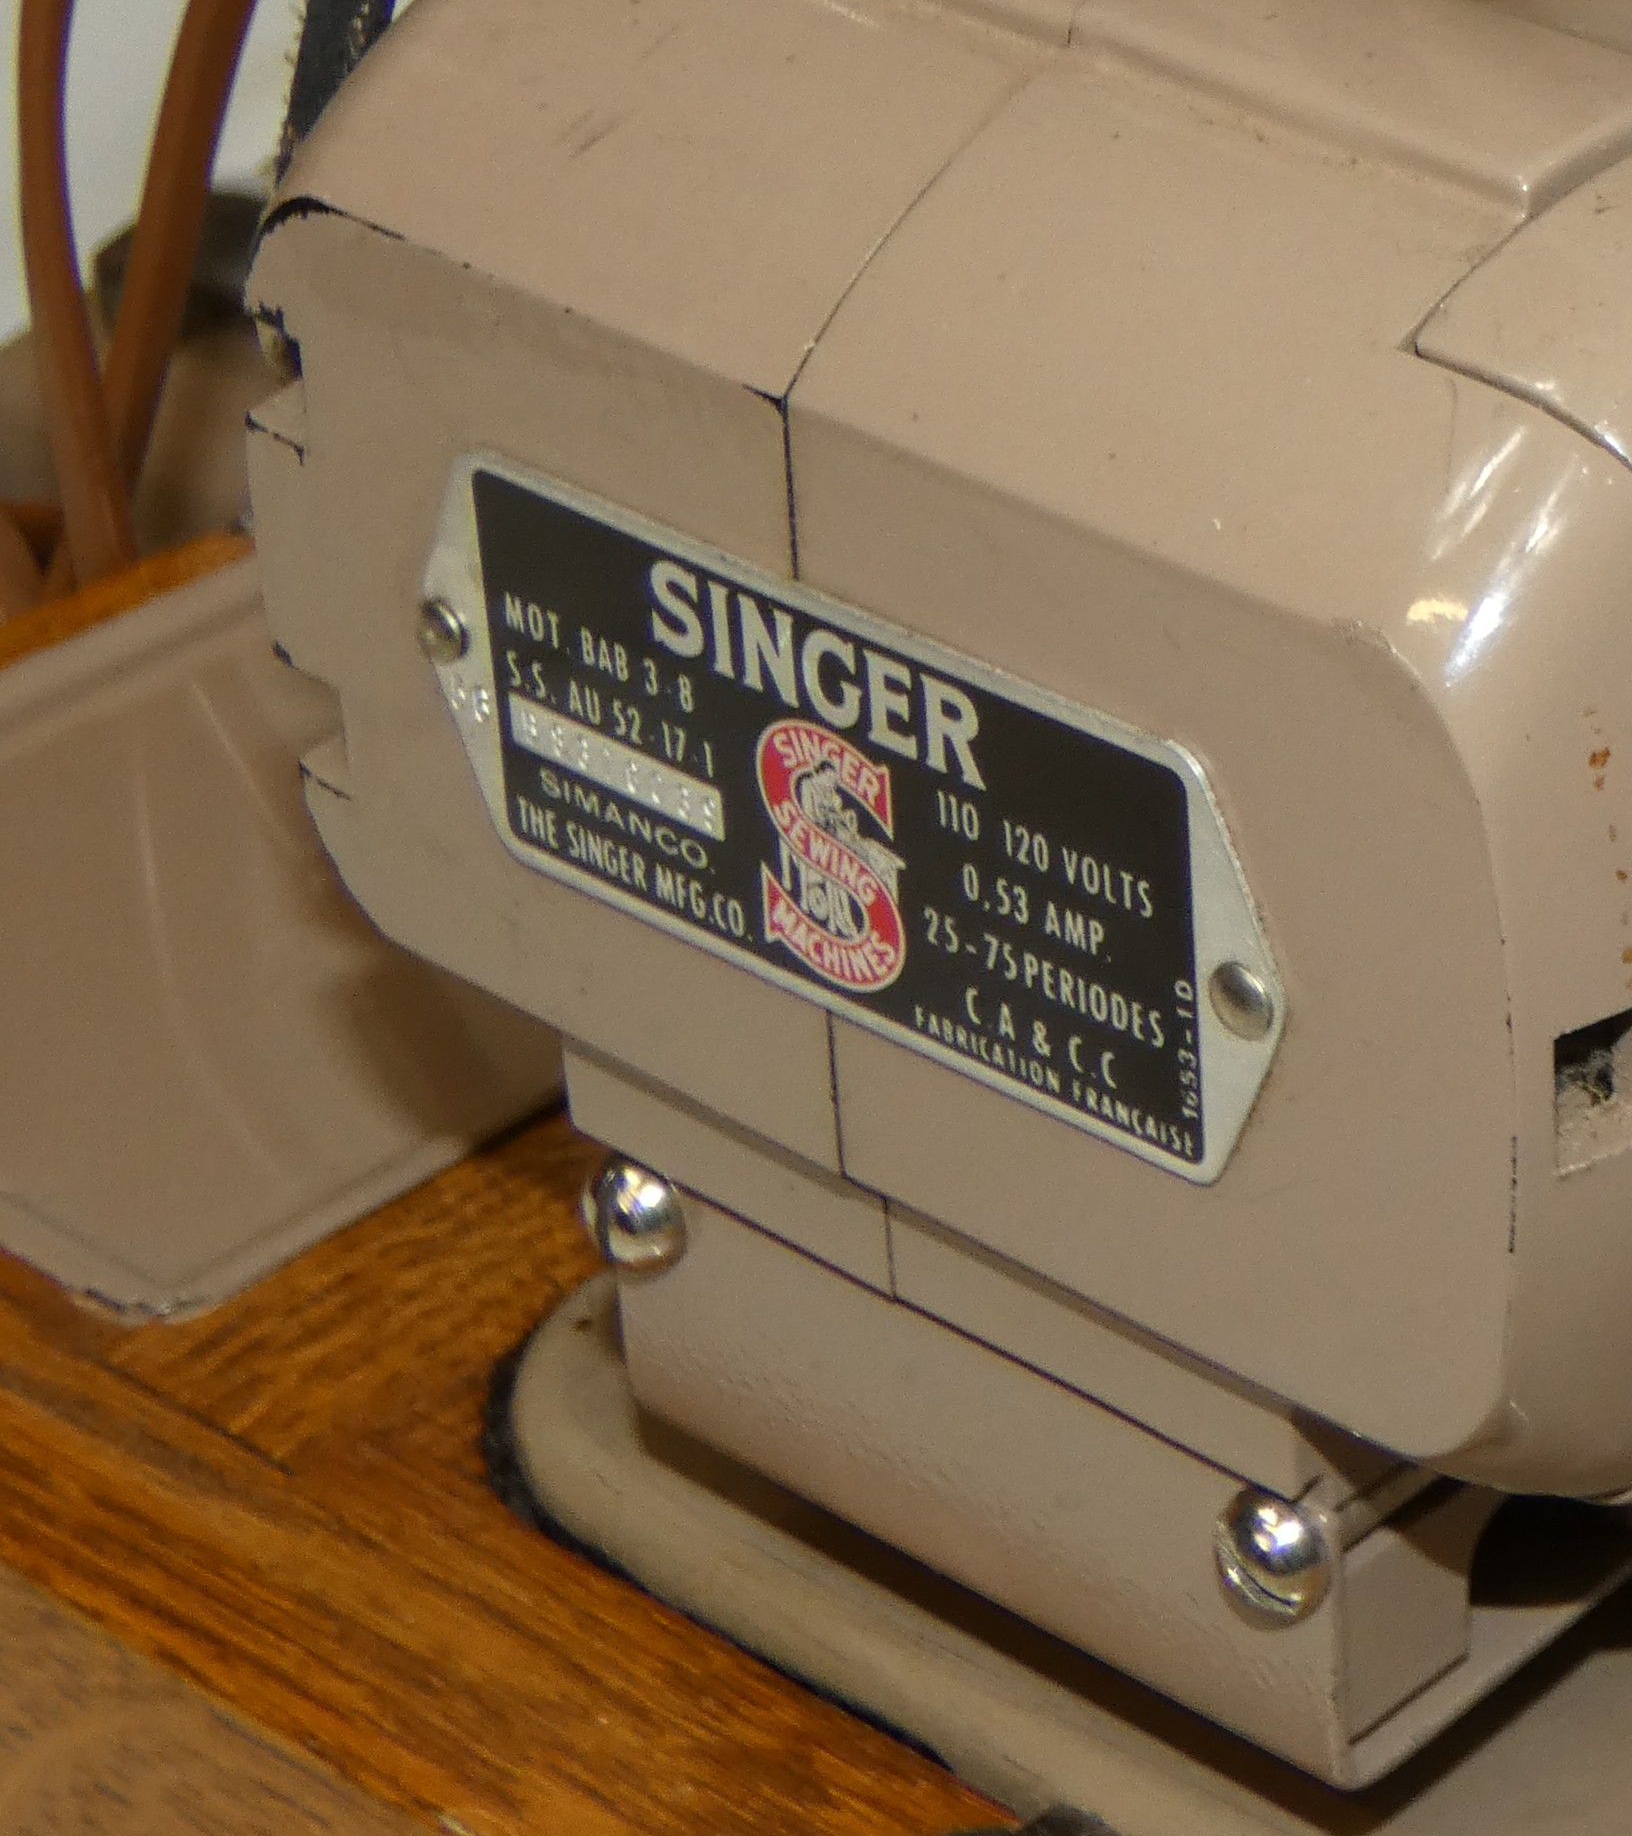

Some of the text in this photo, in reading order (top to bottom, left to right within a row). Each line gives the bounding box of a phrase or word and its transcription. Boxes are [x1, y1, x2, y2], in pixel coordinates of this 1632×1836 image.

[580, 624, 629, 683] BAB
[650, 559, 986, 791] SINGER
[568, 677, 603, 727] AU
[771, 727, 882, 804] SINGER
[516, 794, 559, 851] THE
[565, 819, 648, 894] SINGER
[773, 800, 880, 908] SEWING
[1061, 845, 1154, 919] VOLTS
[962, 862, 1031, 926] 0.53
[771, 896, 897, 984] MACHINES
[914, 1002, 1061, 1094] FABRICATION
